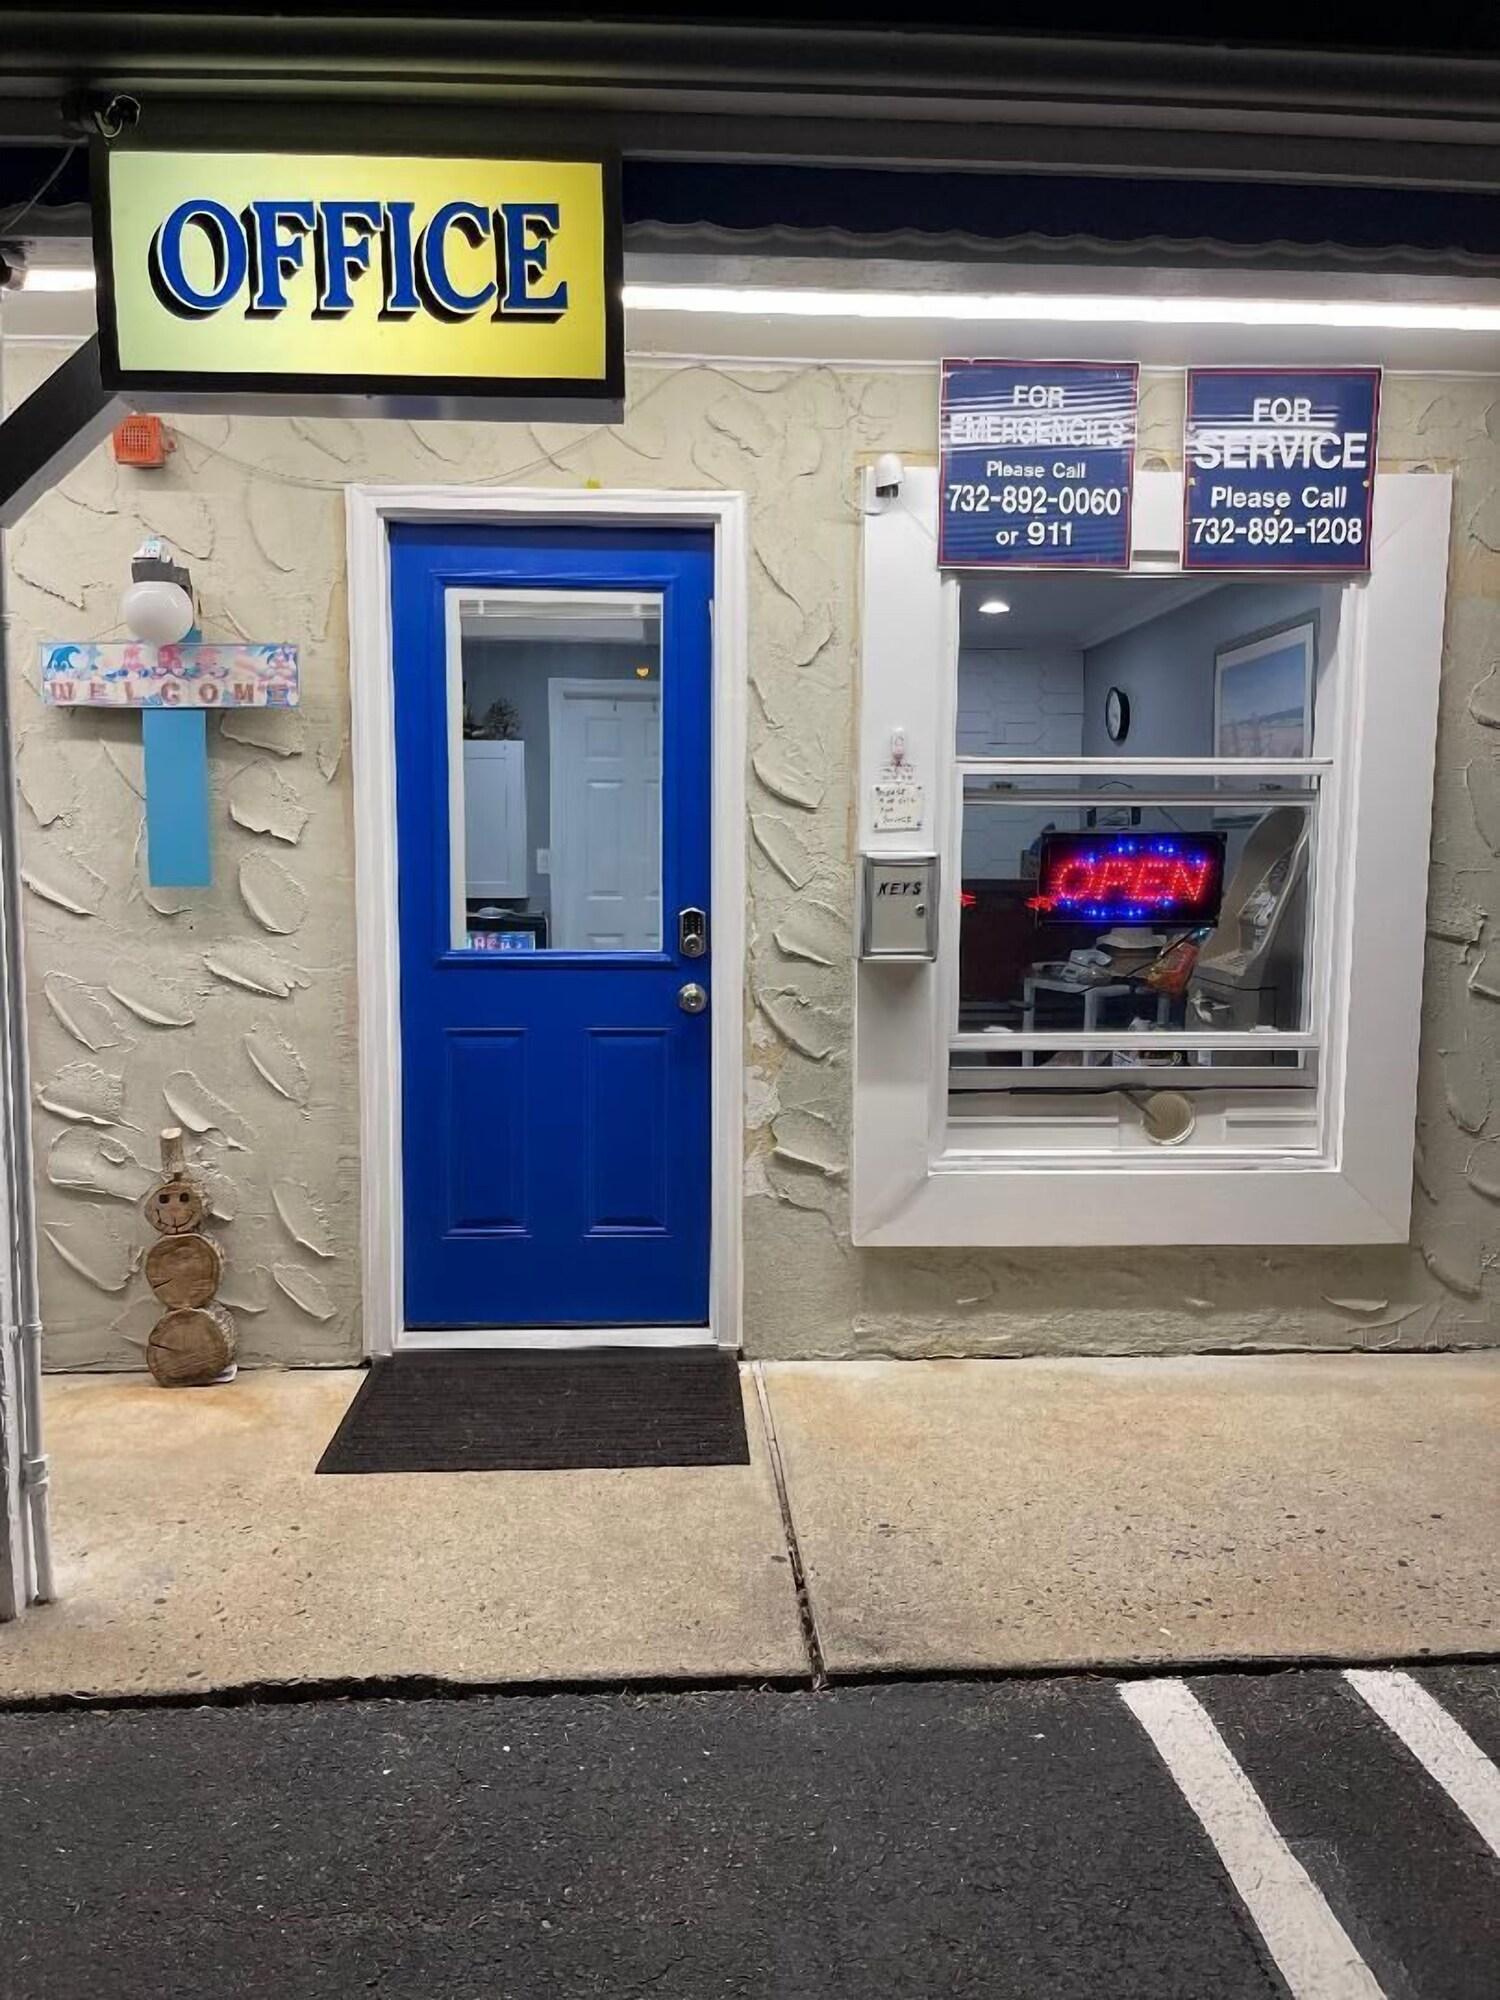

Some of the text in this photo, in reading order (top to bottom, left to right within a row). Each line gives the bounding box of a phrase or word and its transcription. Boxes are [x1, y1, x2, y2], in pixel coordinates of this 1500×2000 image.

[149, 199, 568, 323] OFFICE
[1013, 385, 1065, 409] FOR
[1253, 397, 1312, 422] FOR
[950, 416, 1126, 447] EMERGENCIES
[1195, 432, 1368, 469] SERVICE
[986, 460, 1086, 479] Please Call
[949, 485, 1121, 515] 732-892-0060
[1211, 486, 1347, 508] Please Call
[996, 521, 1073, 546] or 911
[1192, 517, 1362, 544] 732-892-1208
[876, 881, 922, 896] KEYS
[1057, 859, 1208, 900] OPEN
